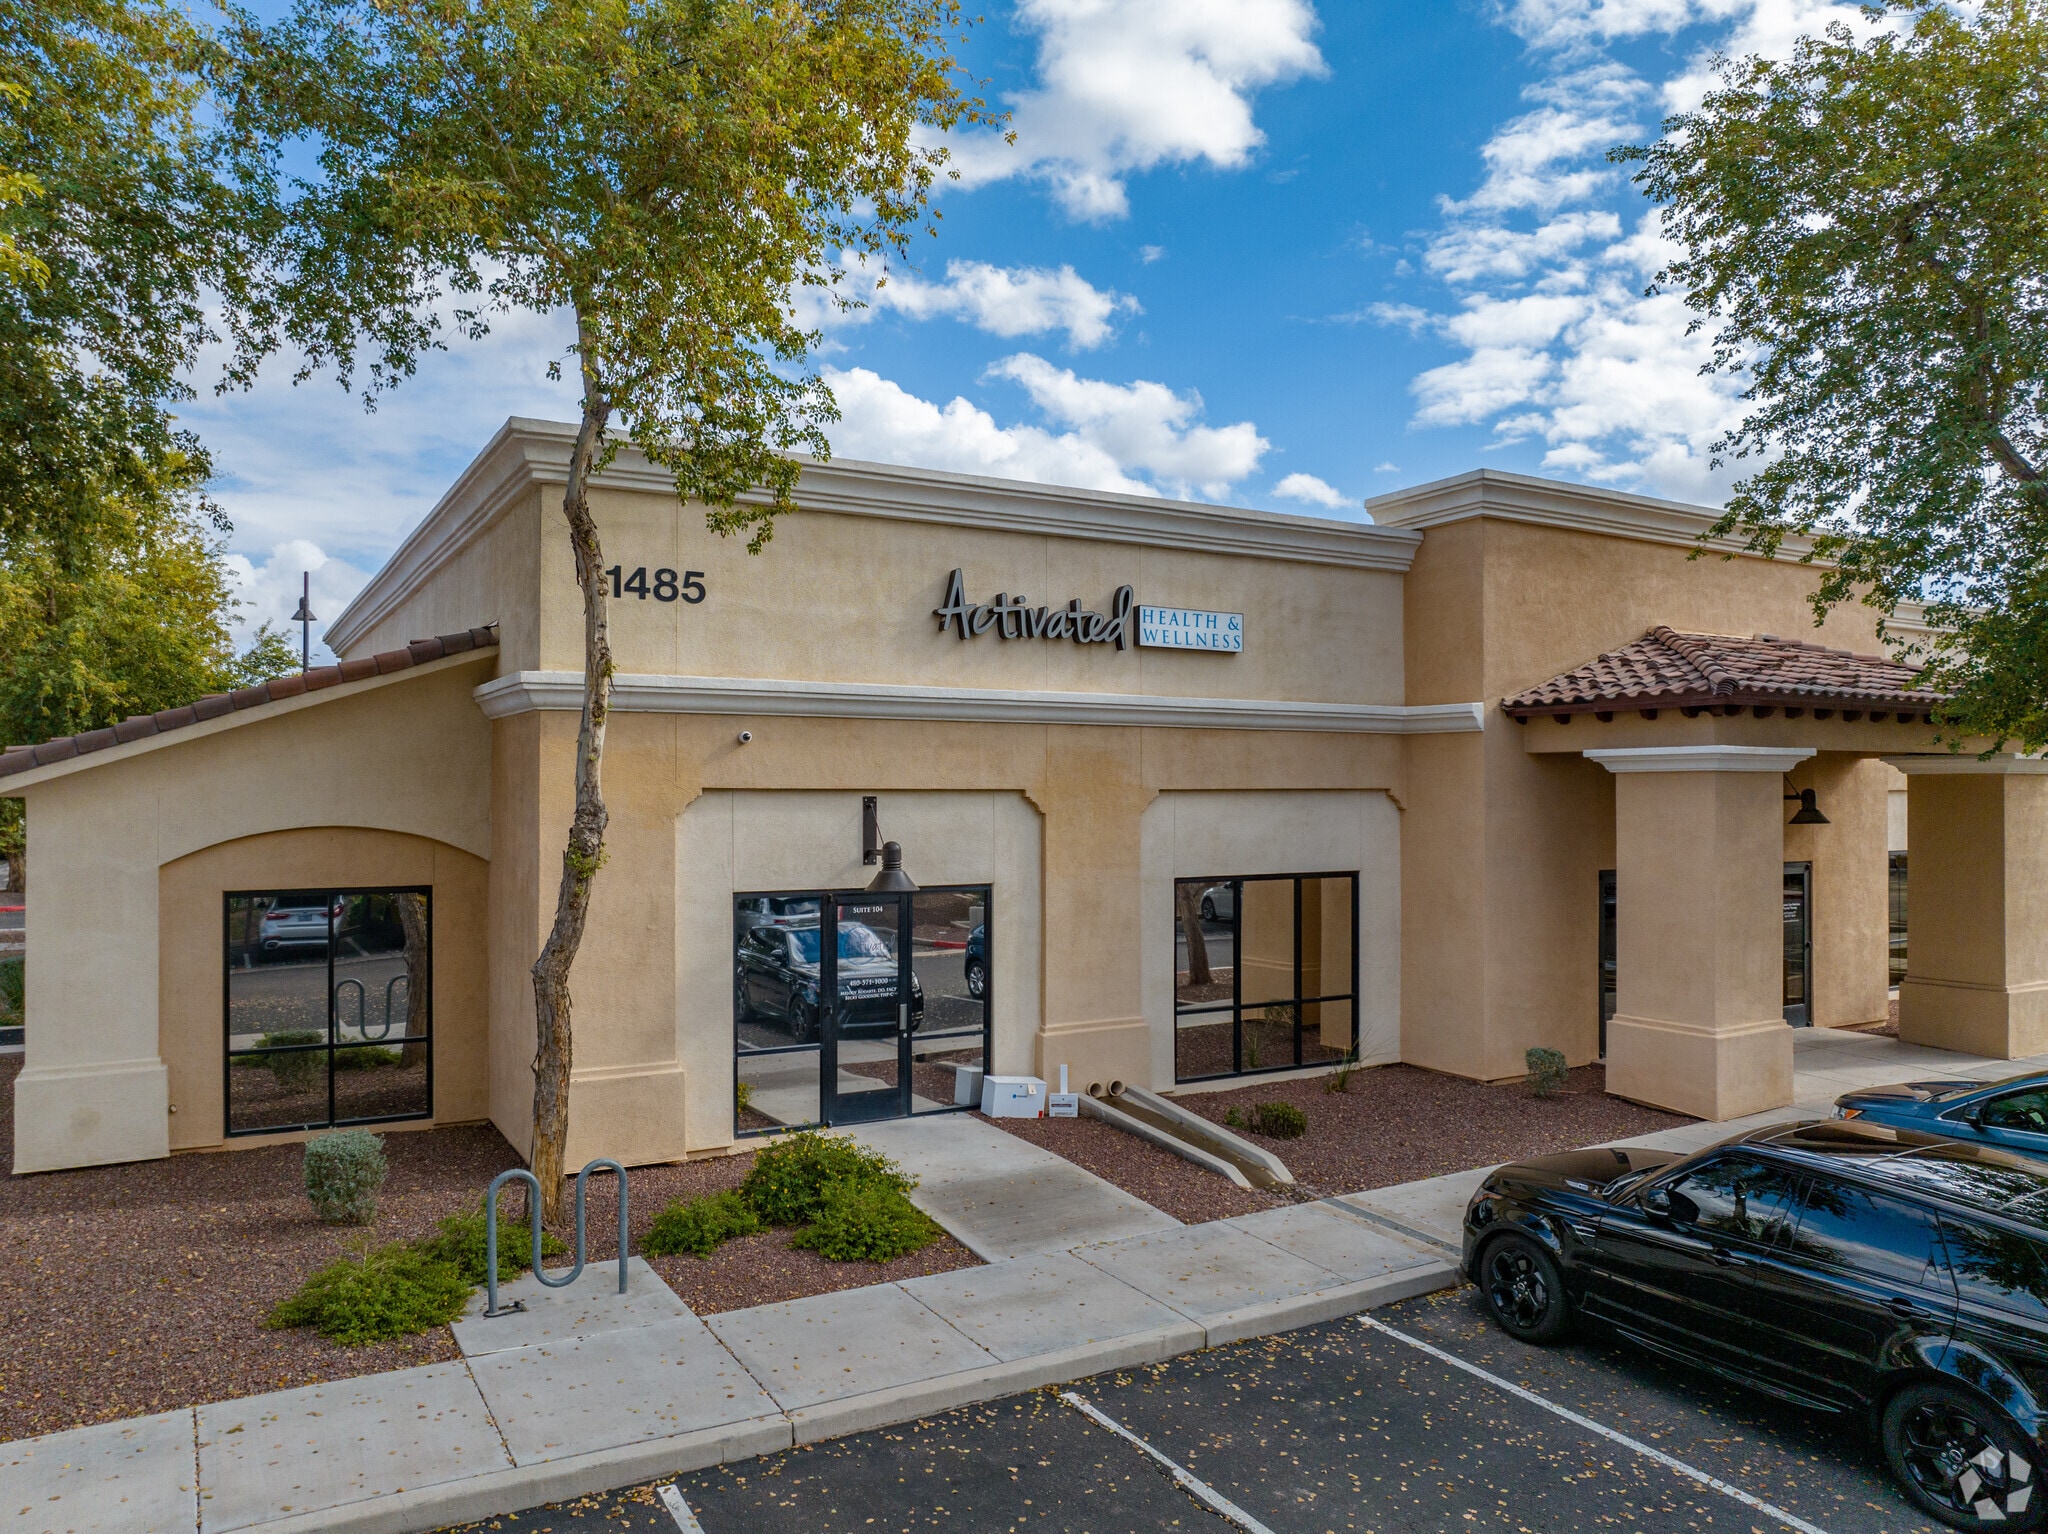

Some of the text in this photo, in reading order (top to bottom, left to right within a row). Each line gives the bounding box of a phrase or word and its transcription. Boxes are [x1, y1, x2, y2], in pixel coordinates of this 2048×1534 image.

[605, 565, 706, 604] 1485
[933, 568, 1134, 651] Activated
[1142, 609, 1241, 631] HEALTH &
[1144, 628, 1241, 650] WELLNESS
